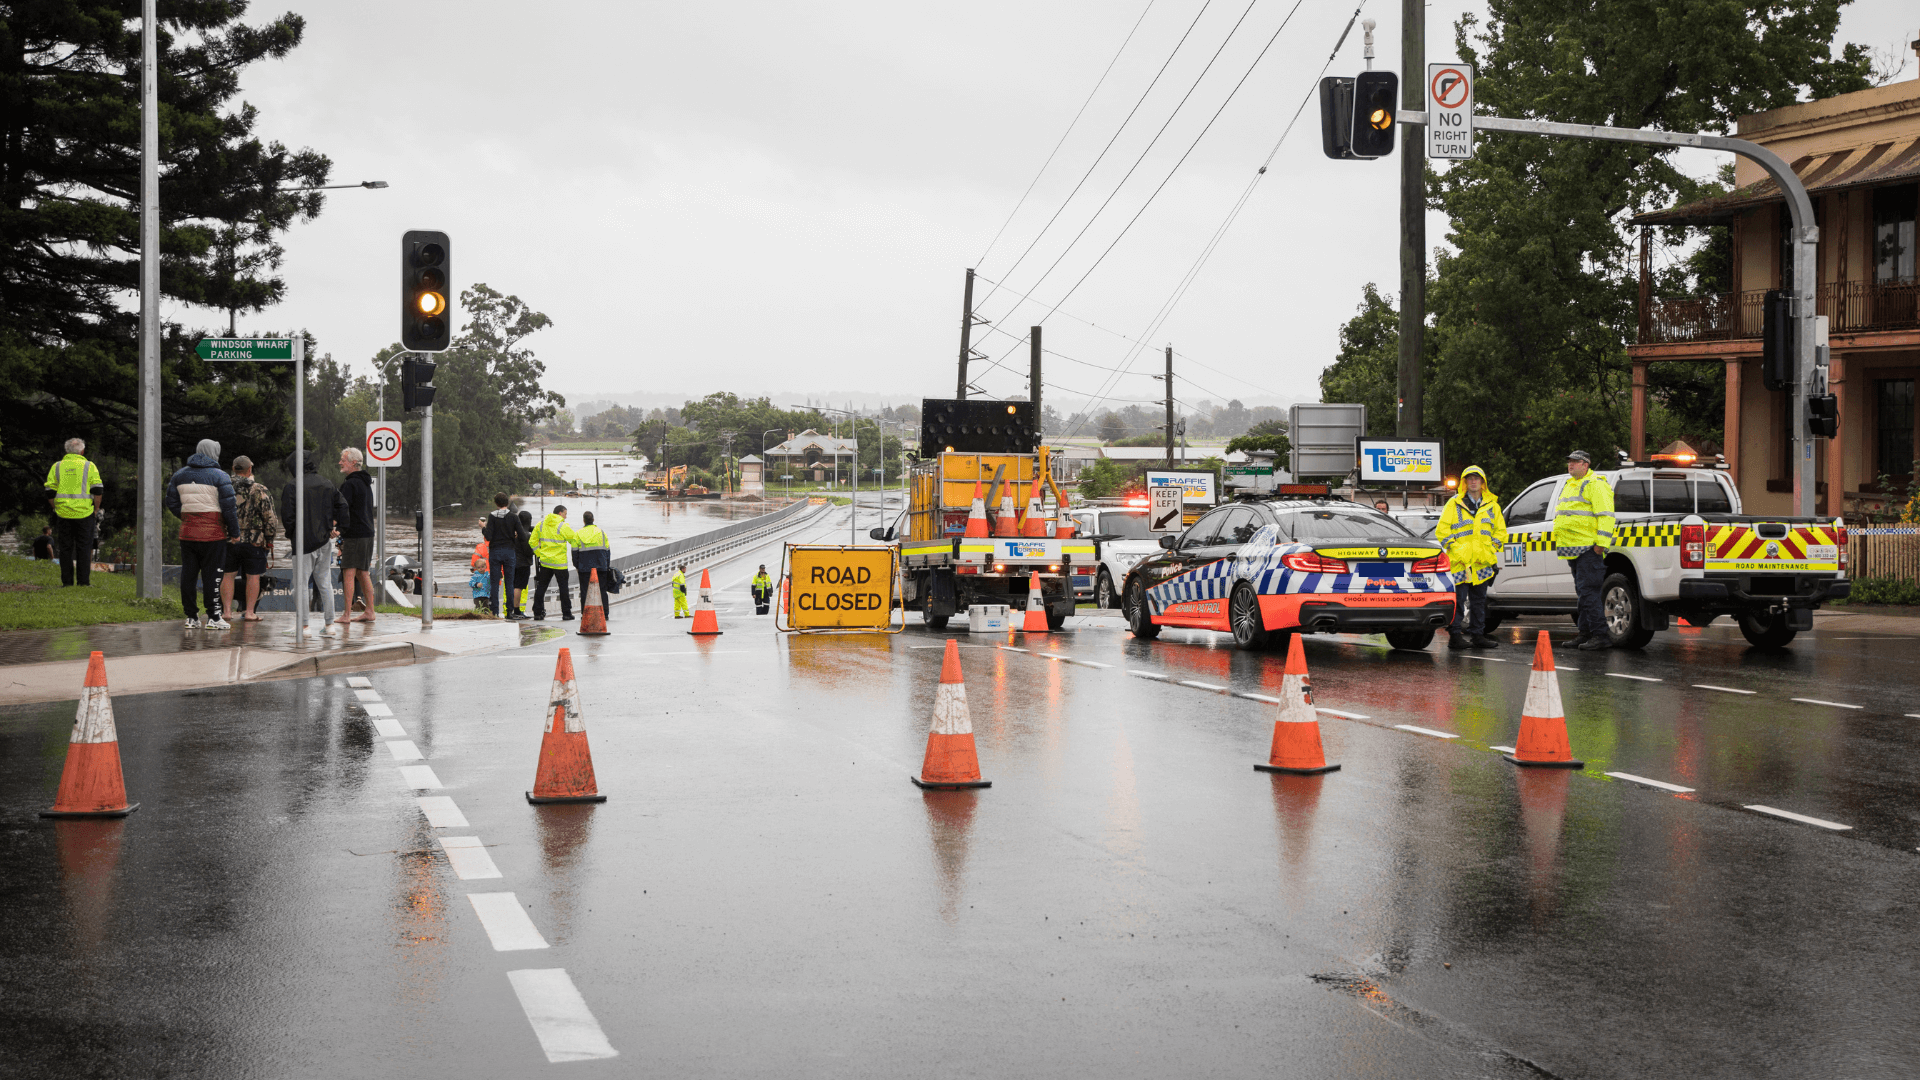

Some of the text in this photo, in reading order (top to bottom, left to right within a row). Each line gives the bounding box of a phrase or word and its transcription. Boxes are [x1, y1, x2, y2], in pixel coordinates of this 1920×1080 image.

[1439, 112, 1462, 127] NO
[1434, 130, 1467, 141] RIGHT
[1435, 144, 1467, 155] TURN
[210, 340, 289, 349] WINDSOR WHARF
[210, 350, 253, 359] PARKING
[373, 436, 396, 452] 50
[1155, 490, 1178, 498] KEEP
[1156, 499, 1177, 508] LEFT
[1504, 545, 1523, 564] DM
[811, 566, 871, 584] ROAD
[1161, 562, 1183, 578] Police
[1366, 578, 1398, 587] Police
[701, 595, 712, 603] TL
[798, 593, 882, 611] CLOSED
[1196, 602, 1221, 614] PATROL
